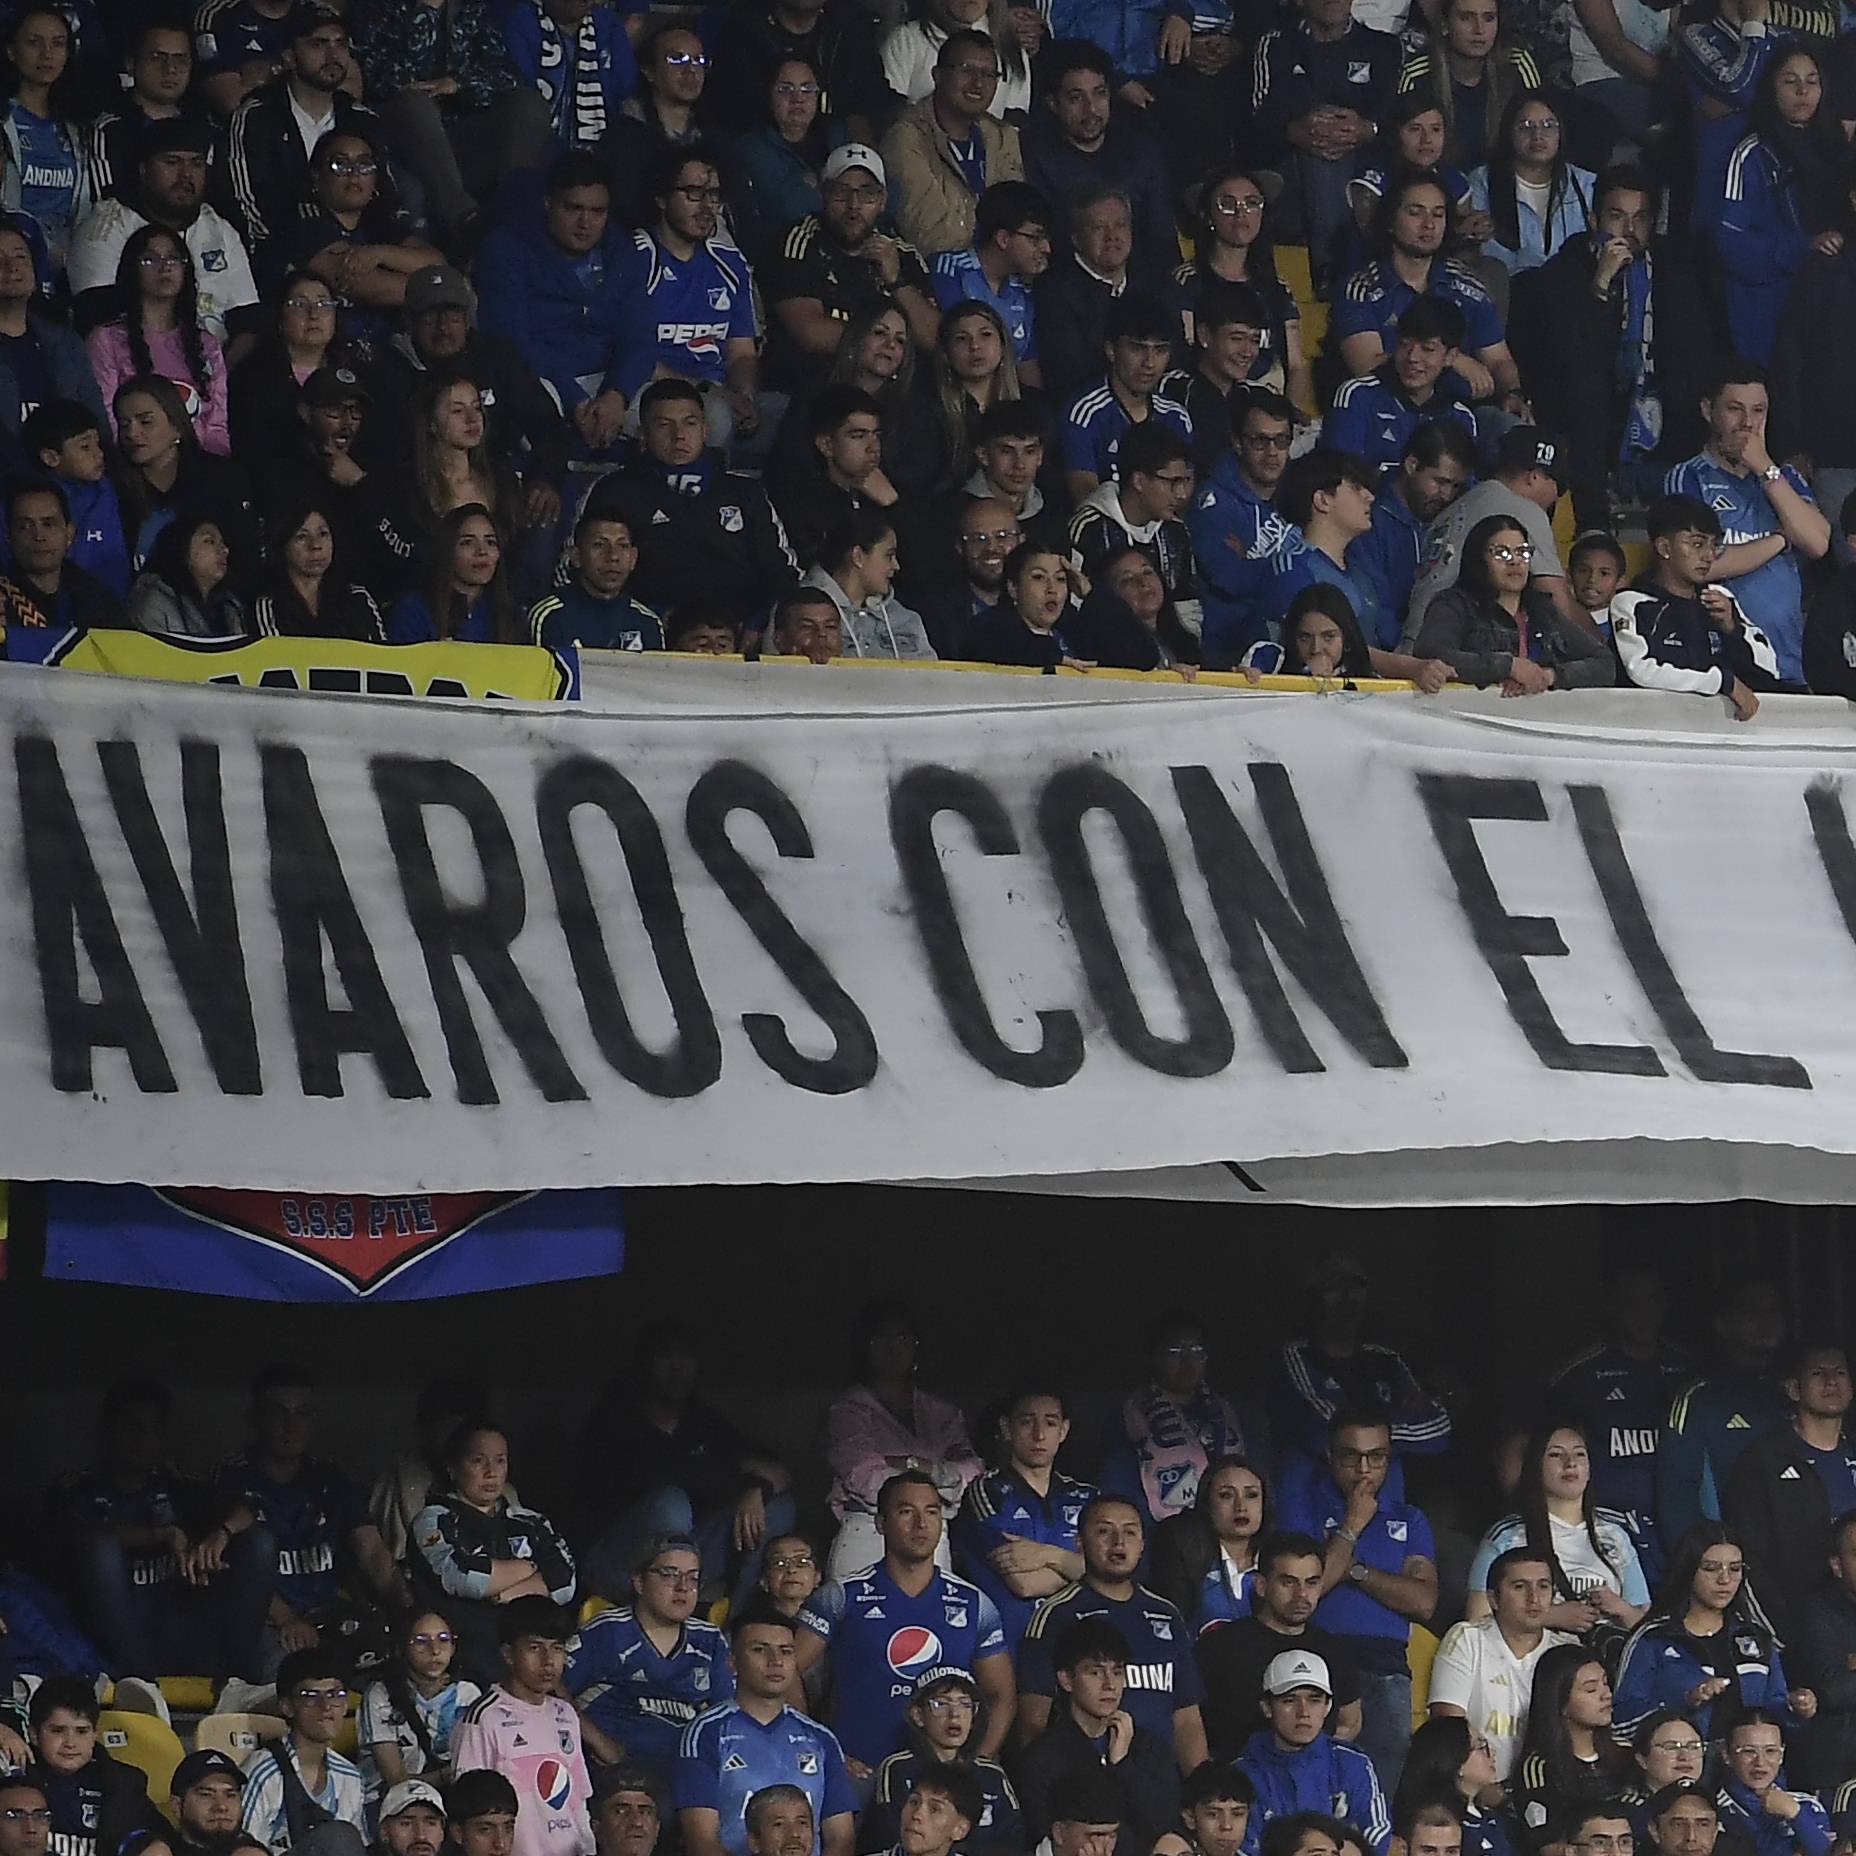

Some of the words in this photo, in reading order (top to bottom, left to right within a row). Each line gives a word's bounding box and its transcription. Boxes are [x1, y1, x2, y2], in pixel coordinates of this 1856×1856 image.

[22, 164, 74, 188] ANDINA
[657, 321, 729, 347] PEPSI
[10, 728, 878, 1106] AVAROS
[888, 753, 1409, 1088] CON
[1415, 772, 1812, 1089] EL
[369, 1196, 437, 1238] PTE
[1121, 1663, 1173, 1693] DINA
